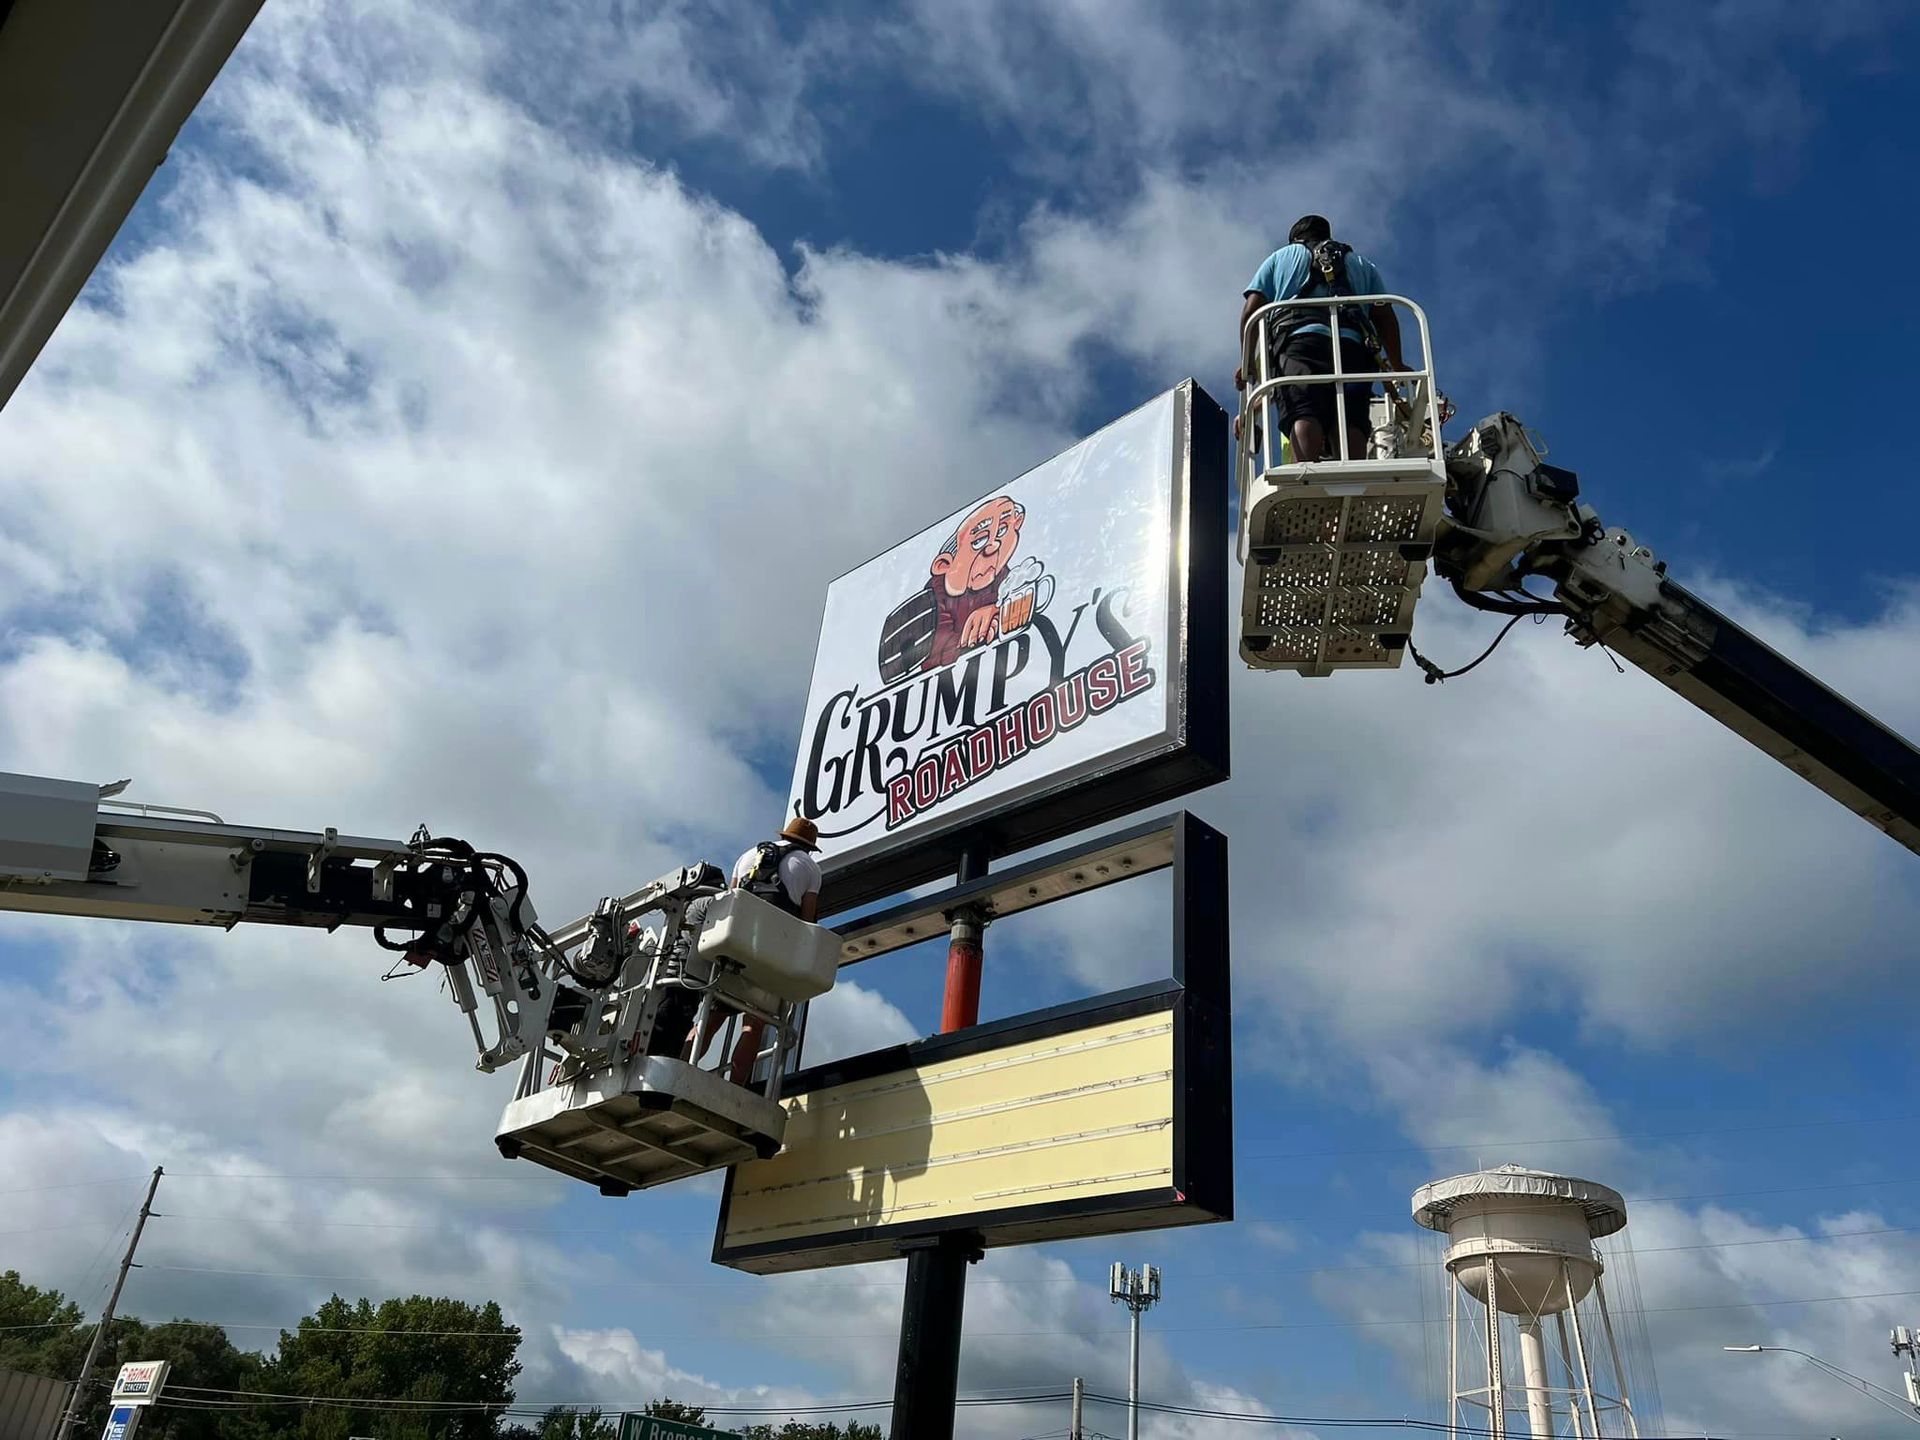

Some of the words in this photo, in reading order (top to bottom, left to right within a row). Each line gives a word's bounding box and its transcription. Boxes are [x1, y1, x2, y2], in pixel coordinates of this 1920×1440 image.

[796, 586, 1136, 836] GRUMPY'S
[886, 639, 1156, 830] ROADHOUSE
[126, 1367, 156, 1381] RE/MAX
[124, 1383, 148, 1392] CONCEPTS
[630, 1418, 644, 1440] W
[649, 1422, 703, 1440] Brem
